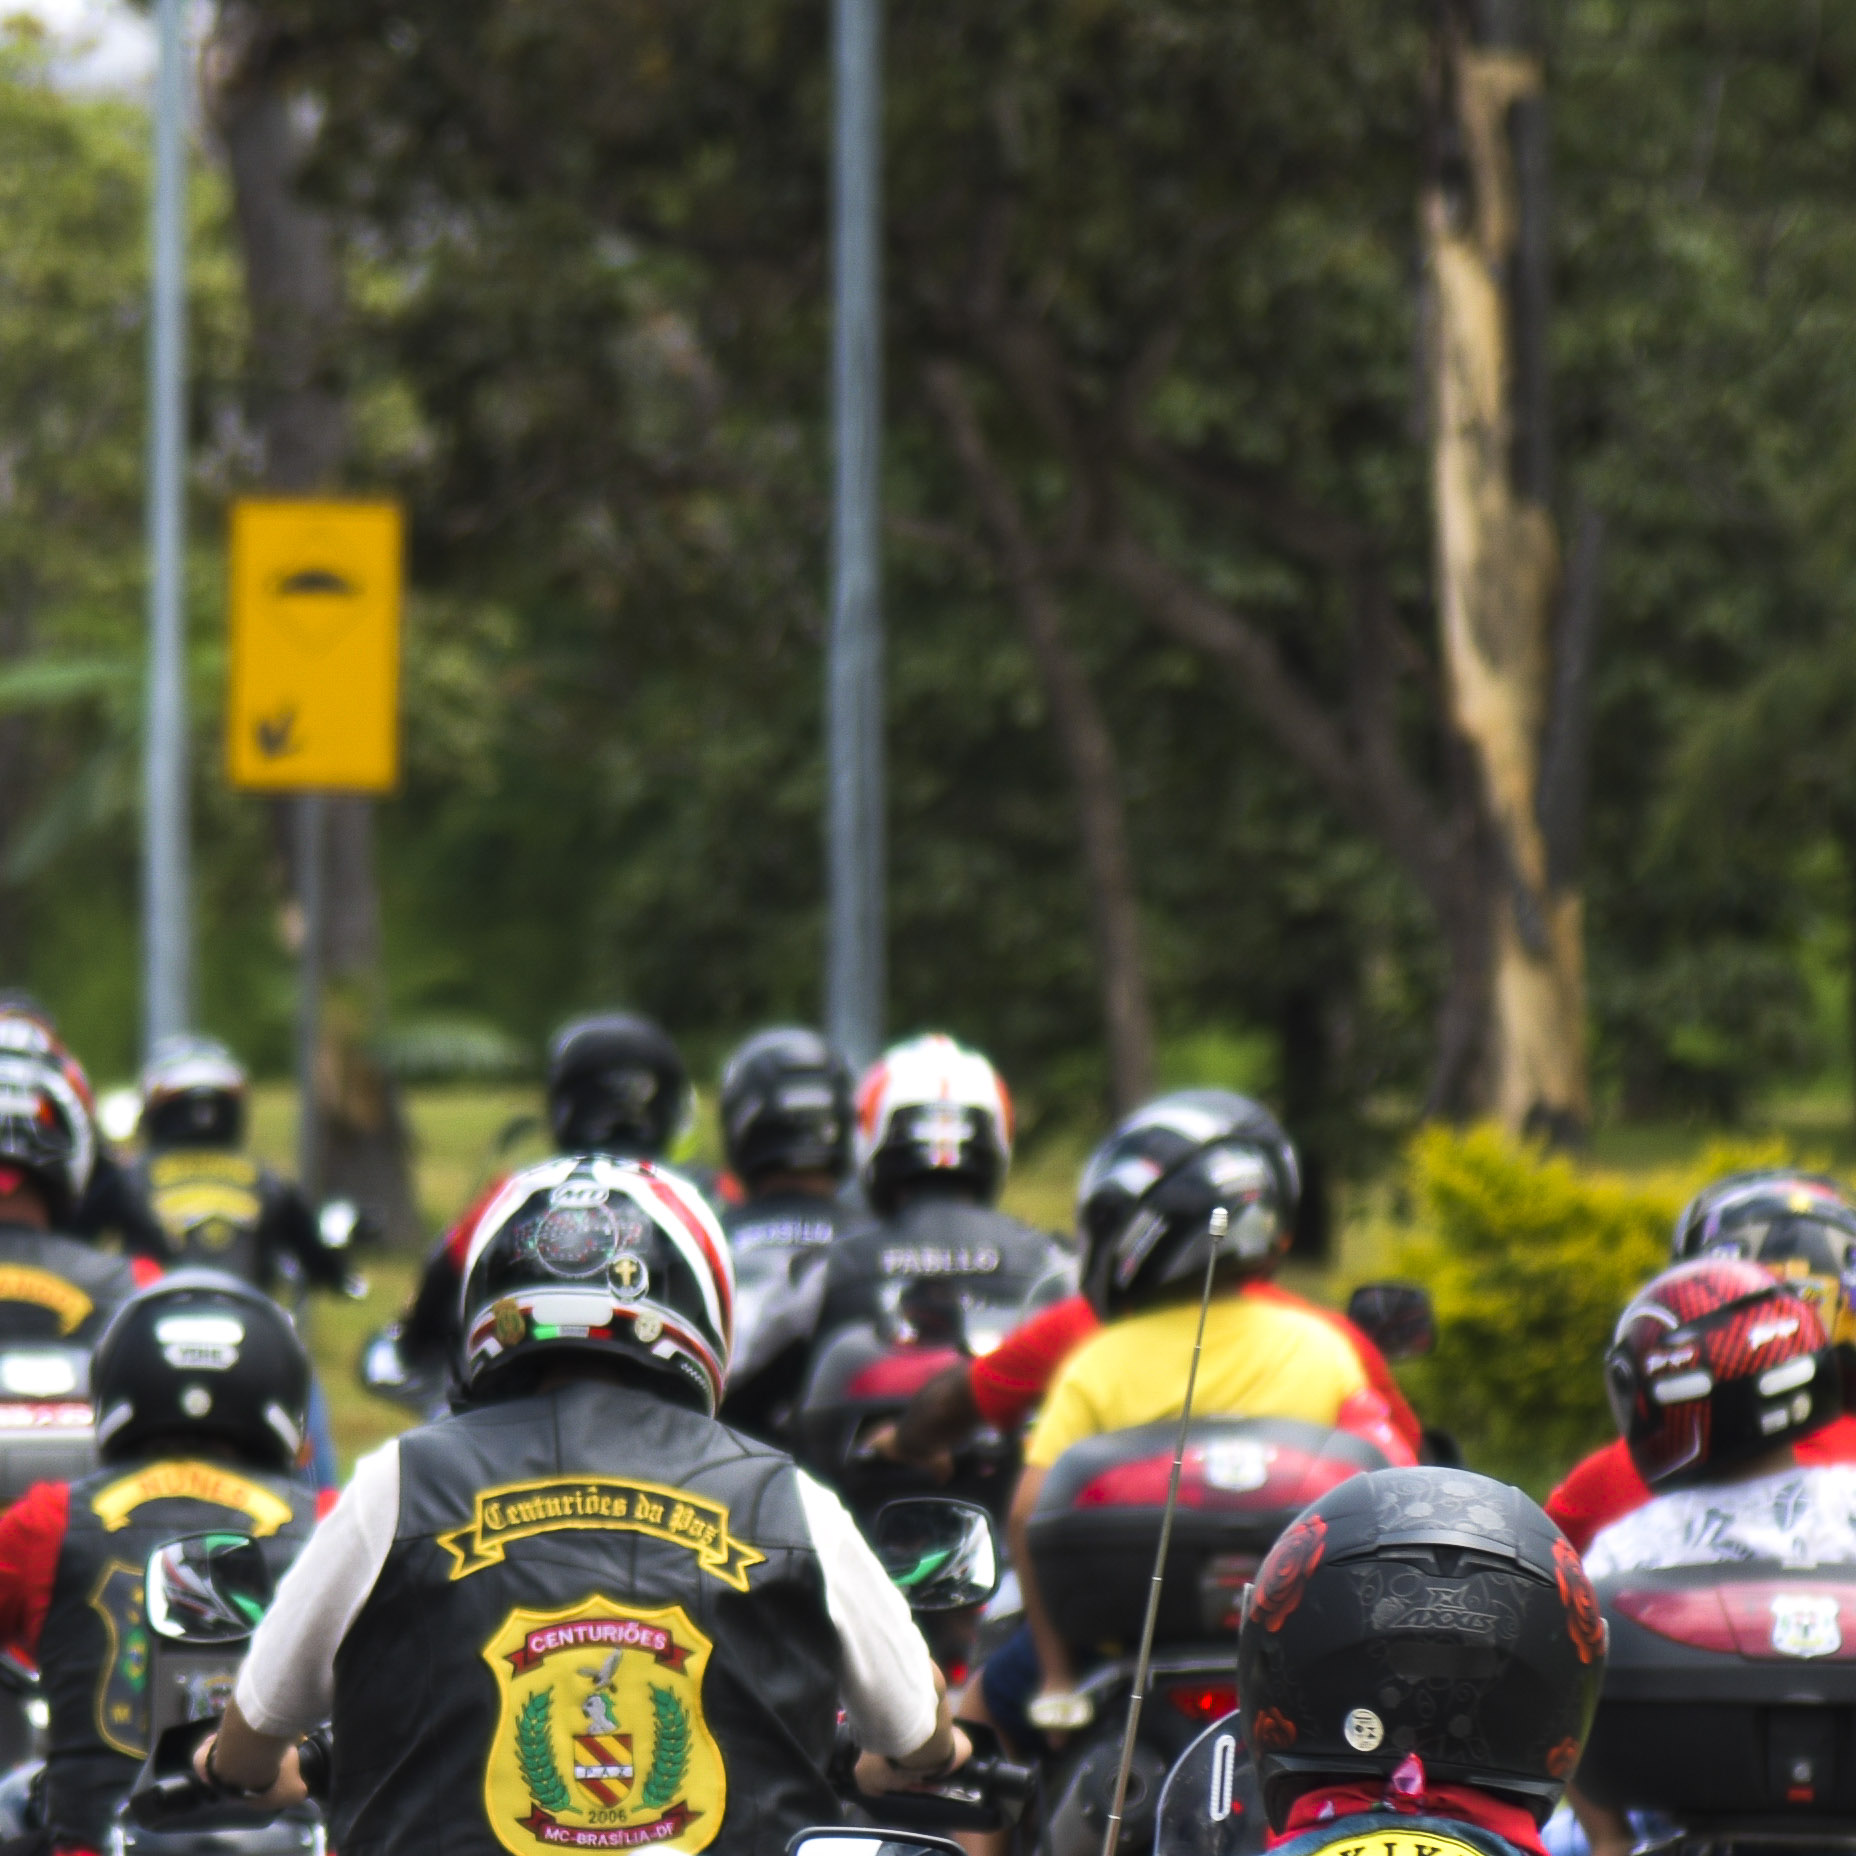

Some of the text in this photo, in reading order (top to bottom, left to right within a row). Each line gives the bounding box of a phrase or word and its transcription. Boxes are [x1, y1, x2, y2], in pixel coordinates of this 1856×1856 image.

[669, 1502, 719, 1547] Paz
[530, 1621, 668, 1653] CENTURIÕES
[588, 1810, 628, 1824] 2006
